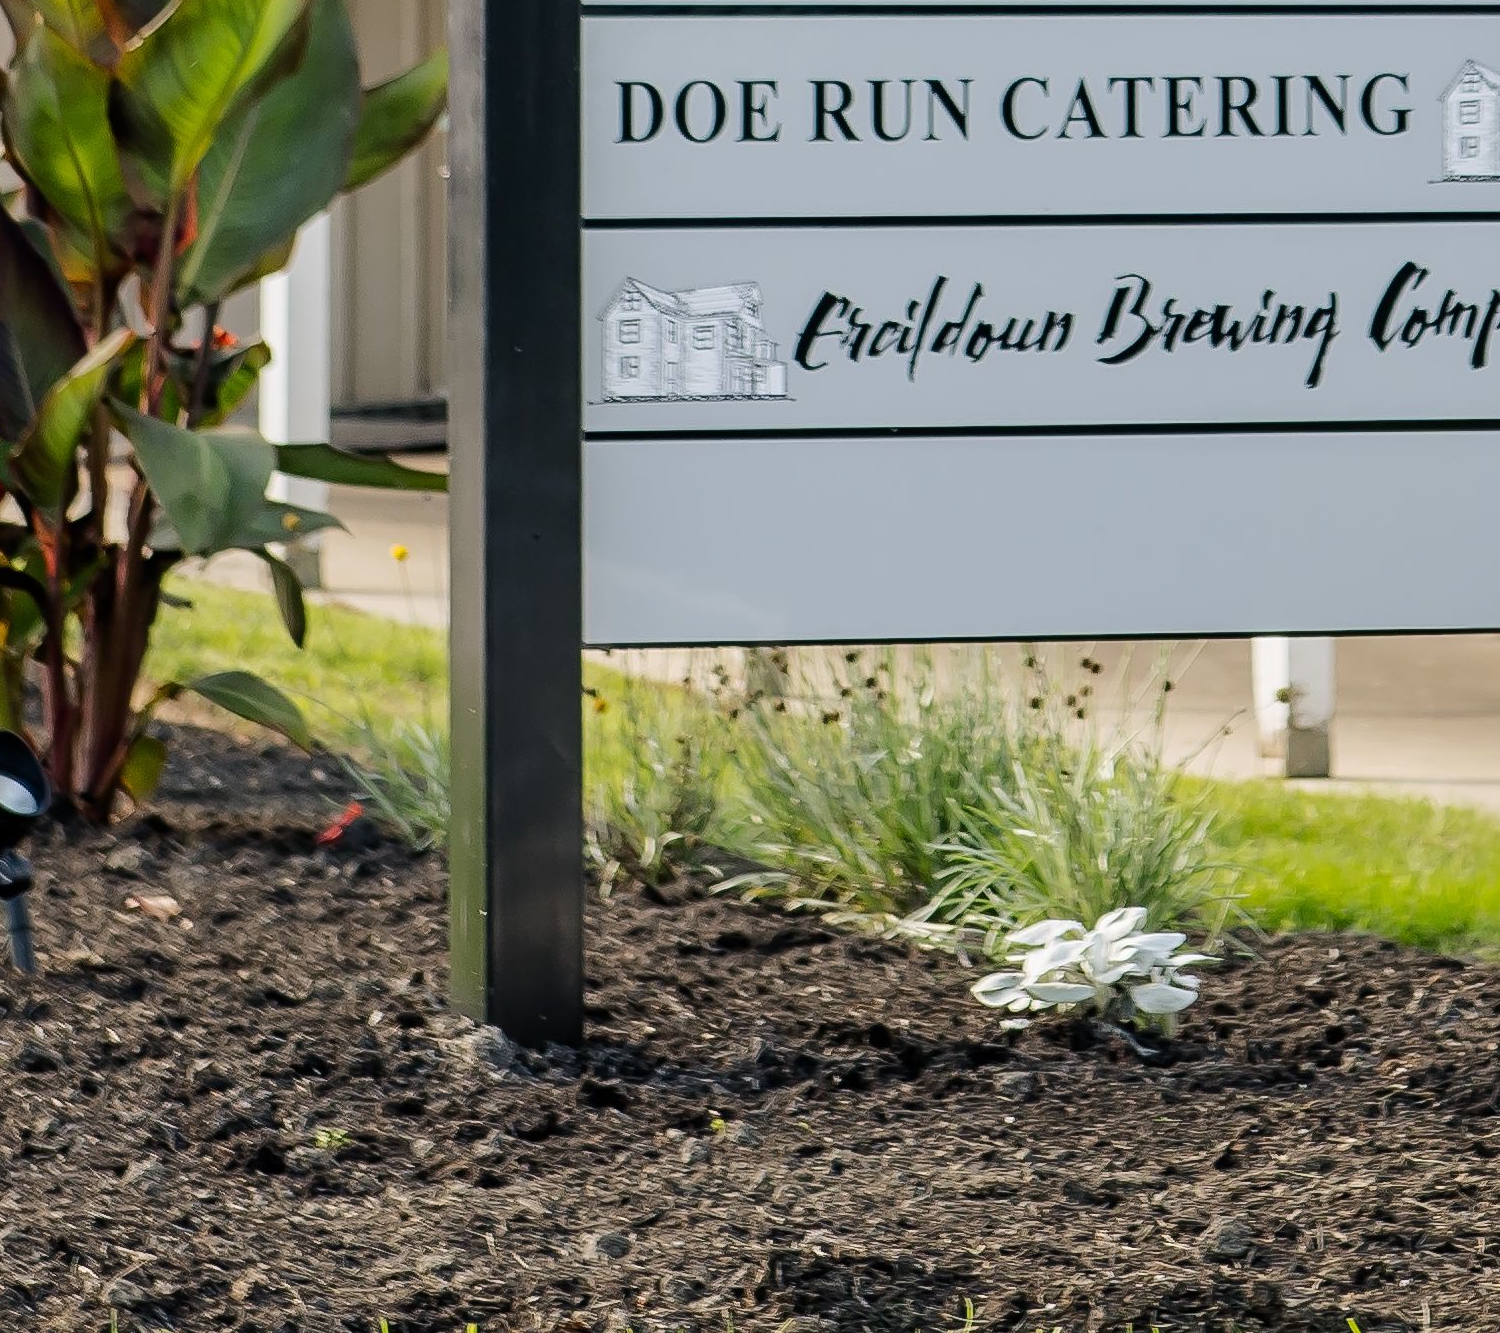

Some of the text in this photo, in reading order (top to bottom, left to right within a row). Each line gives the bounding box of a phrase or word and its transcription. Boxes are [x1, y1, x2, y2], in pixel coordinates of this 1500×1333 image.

[614, 71, 1413, 145] DOE RUN CATERING
[795, 274, 1076, 383] Ercildoun
[1096, 273, 1340, 389] Brewing
